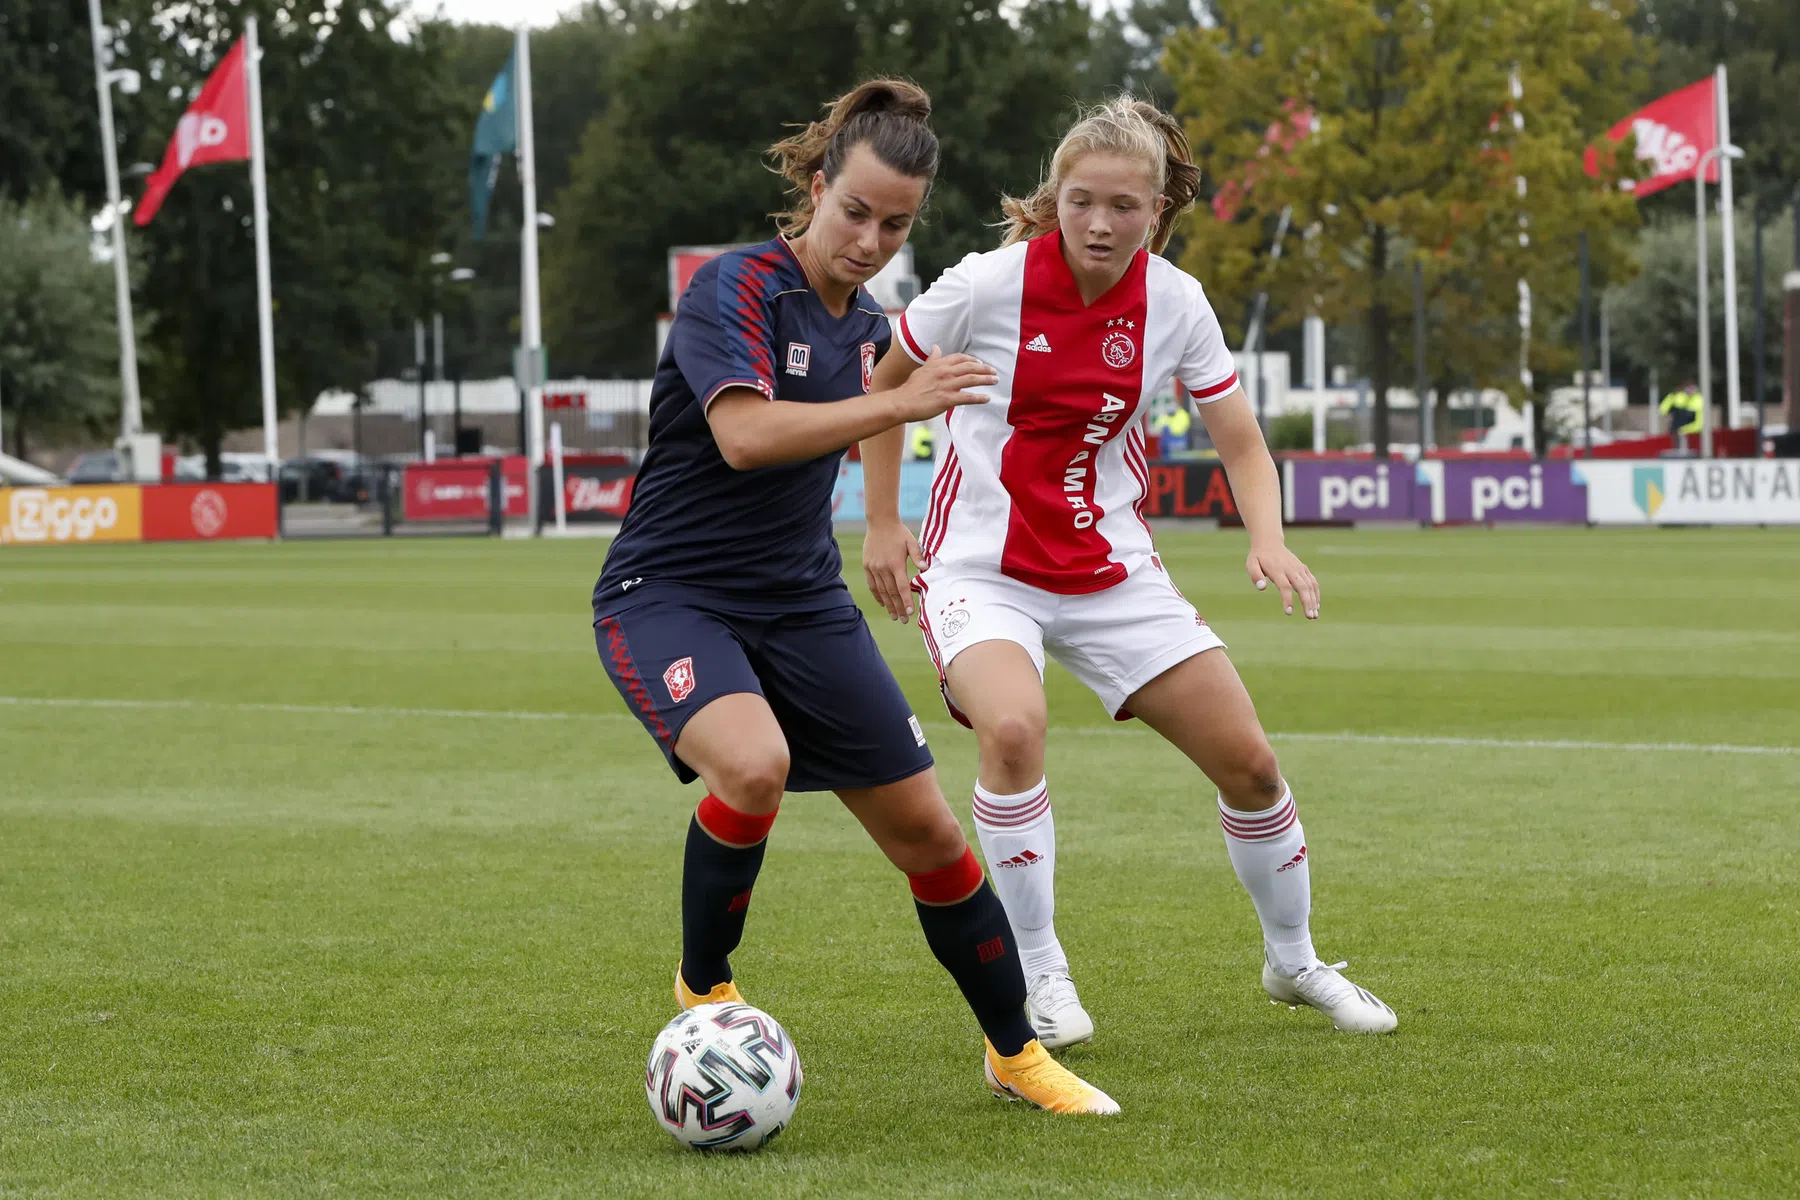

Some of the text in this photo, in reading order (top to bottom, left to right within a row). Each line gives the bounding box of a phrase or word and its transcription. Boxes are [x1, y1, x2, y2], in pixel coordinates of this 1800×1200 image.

[1025, 344, 1051, 352] adidas
[1102, 332, 1119, 348] AJAX
[1063, 392, 1126, 529] ABN AMRO
[572, 477, 625, 510] Bud
[1320, 464, 1389, 520] pci
[1472, 464, 1543, 521] pci
[996, 854, 1044, 868] adidas
